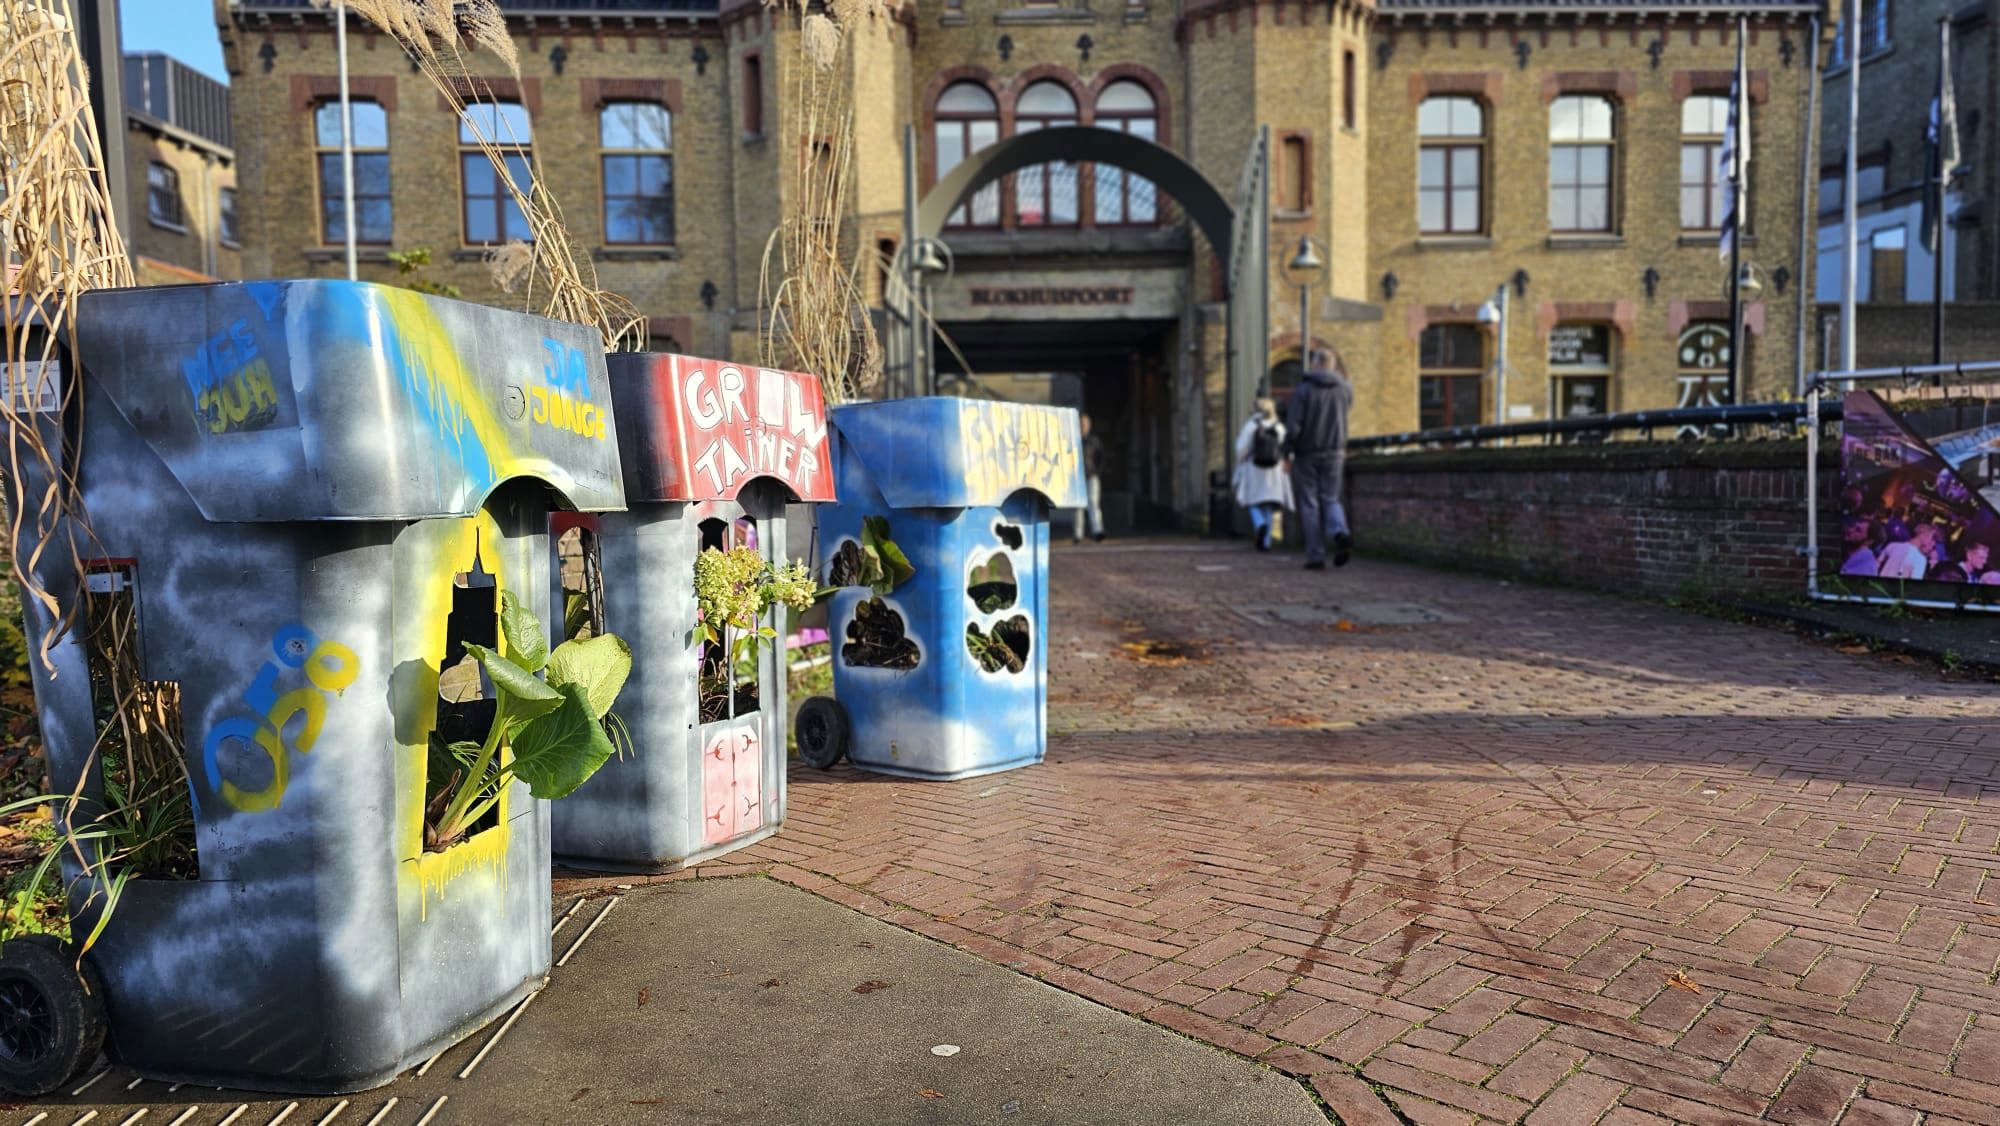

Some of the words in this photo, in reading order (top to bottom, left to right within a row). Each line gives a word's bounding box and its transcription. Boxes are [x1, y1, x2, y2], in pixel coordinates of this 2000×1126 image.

[970, 286, 1134, 306] BLOKHUISPOORT
[543, 336, 592, 399] JA
[531, 385, 605, 441] JONGE
[684, 366, 827, 449] GROW
